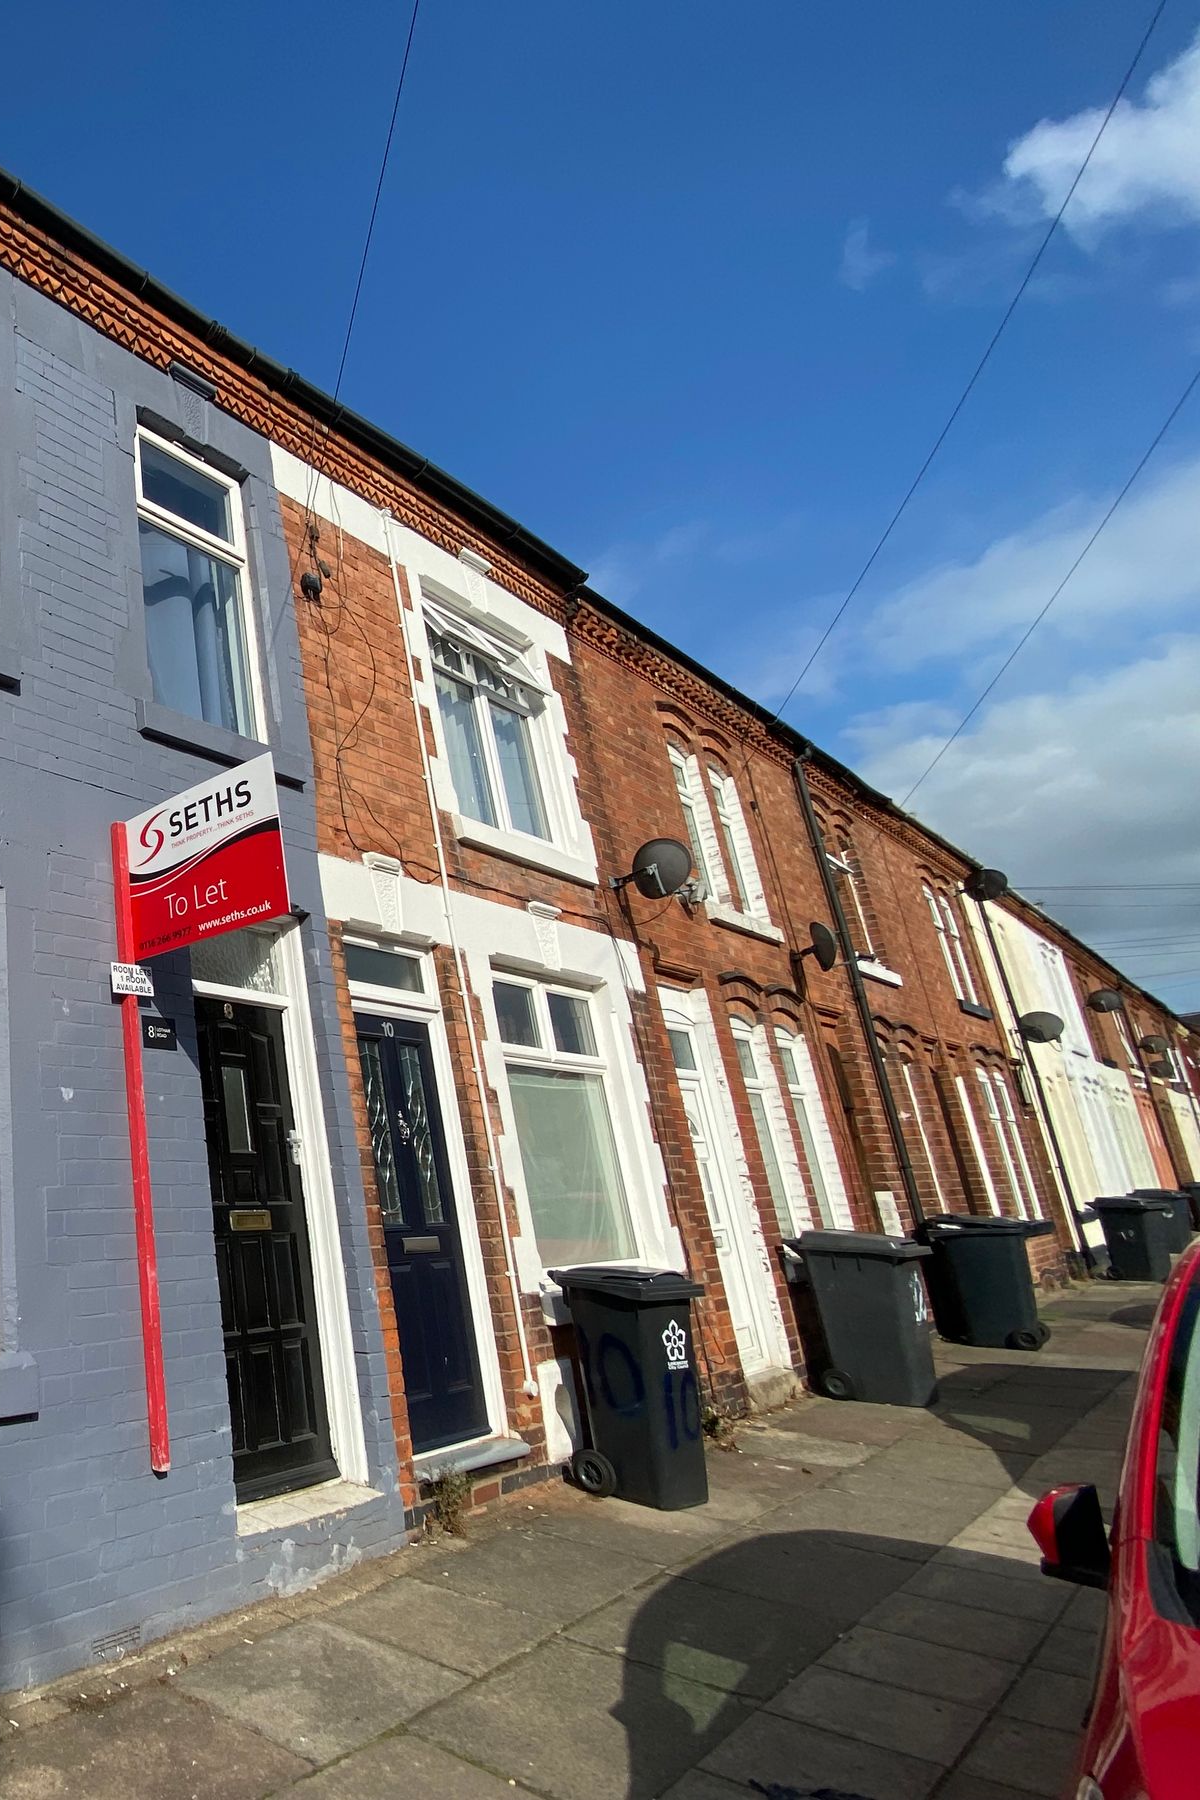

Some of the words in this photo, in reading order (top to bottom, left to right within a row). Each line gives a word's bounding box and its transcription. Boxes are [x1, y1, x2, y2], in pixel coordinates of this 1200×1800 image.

[169, 780, 252, 837] SETHS
[171, 836, 185, 849] THINK
[235, 809, 255, 824] SETHS
[163, 892, 188, 919] To
[193, 878, 229, 910] Let
[198, 900, 272, 932] www.seths.co.uk
[113, 965, 134, 975] ROOM
[116, 983, 152, 994] AVAILABLE
[125, 975, 147, 985] ROOM
[223, 1003, 234, 1020] 8
[147, 1025, 155, 1038] 8
[381, 1021, 395, 1038] 10
[664, 1371, 702, 1450] 10
